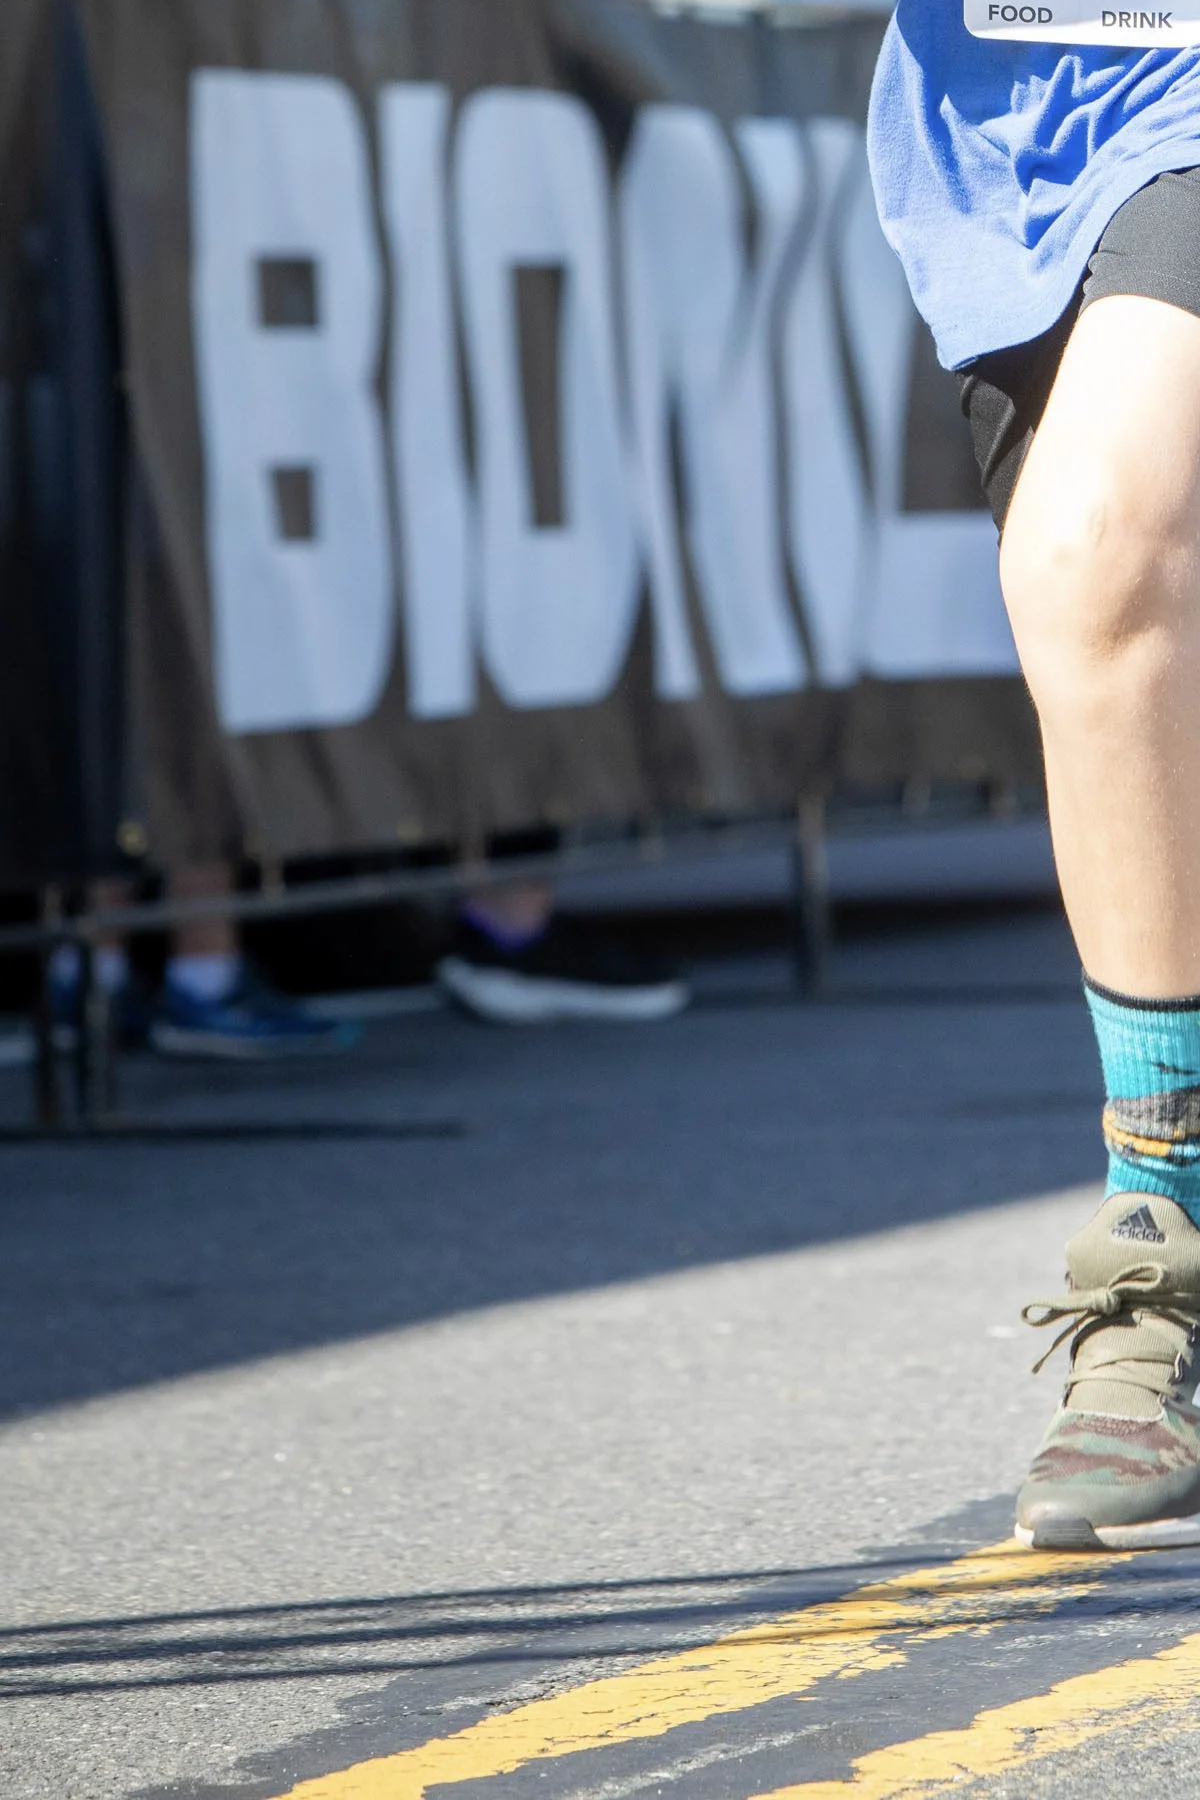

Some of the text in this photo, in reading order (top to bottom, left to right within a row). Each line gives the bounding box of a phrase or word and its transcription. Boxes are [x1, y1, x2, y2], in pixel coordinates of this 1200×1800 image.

[988, 4, 1053, 24] FOOD
[1101, 9, 1173, 29] DRINK
[1112, 1227, 1165, 1243] adidas
